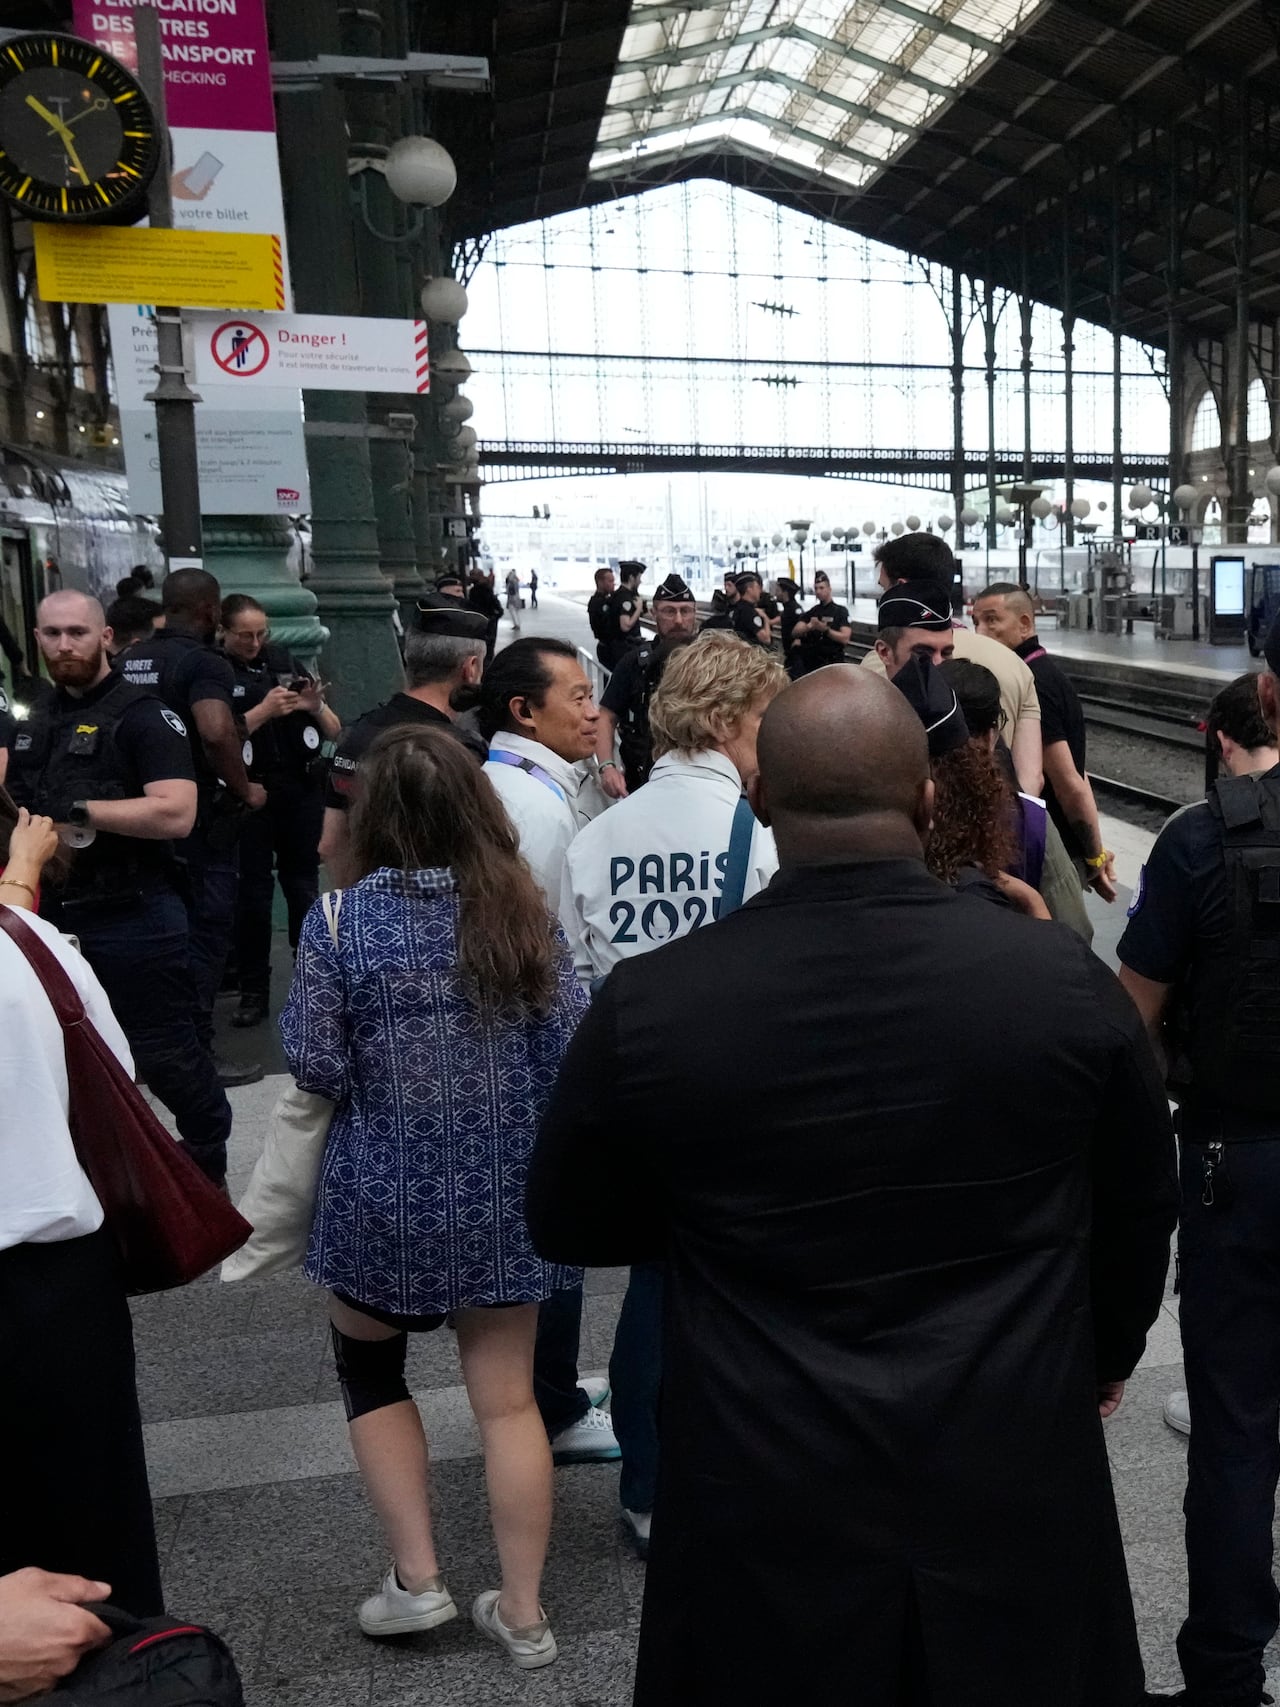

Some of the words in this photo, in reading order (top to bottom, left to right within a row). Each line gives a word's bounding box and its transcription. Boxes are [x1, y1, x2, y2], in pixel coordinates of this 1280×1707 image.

[92, 13, 134, 33] DES
[158, 18, 210, 38] TRES
[129, 41, 256, 65] ANSPORT
[162, 69, 227, 86] HECKING
[179, 208, 213, 219] votre
[216, 208, 248, 220] billet
[278, 329, 336, 348] Danger
[341, 333, 347, 346] !
[278, 349, 298, 359] Pour
[300, 351, 322, 360] votre
[325, 352, 359, 361] sécurité
[1146, 527, 1156, 540] R
[1171, 527, 1181, 540] R
[124, 659, 153, 671] SURETE
[609, 896, 729, 944] 202
